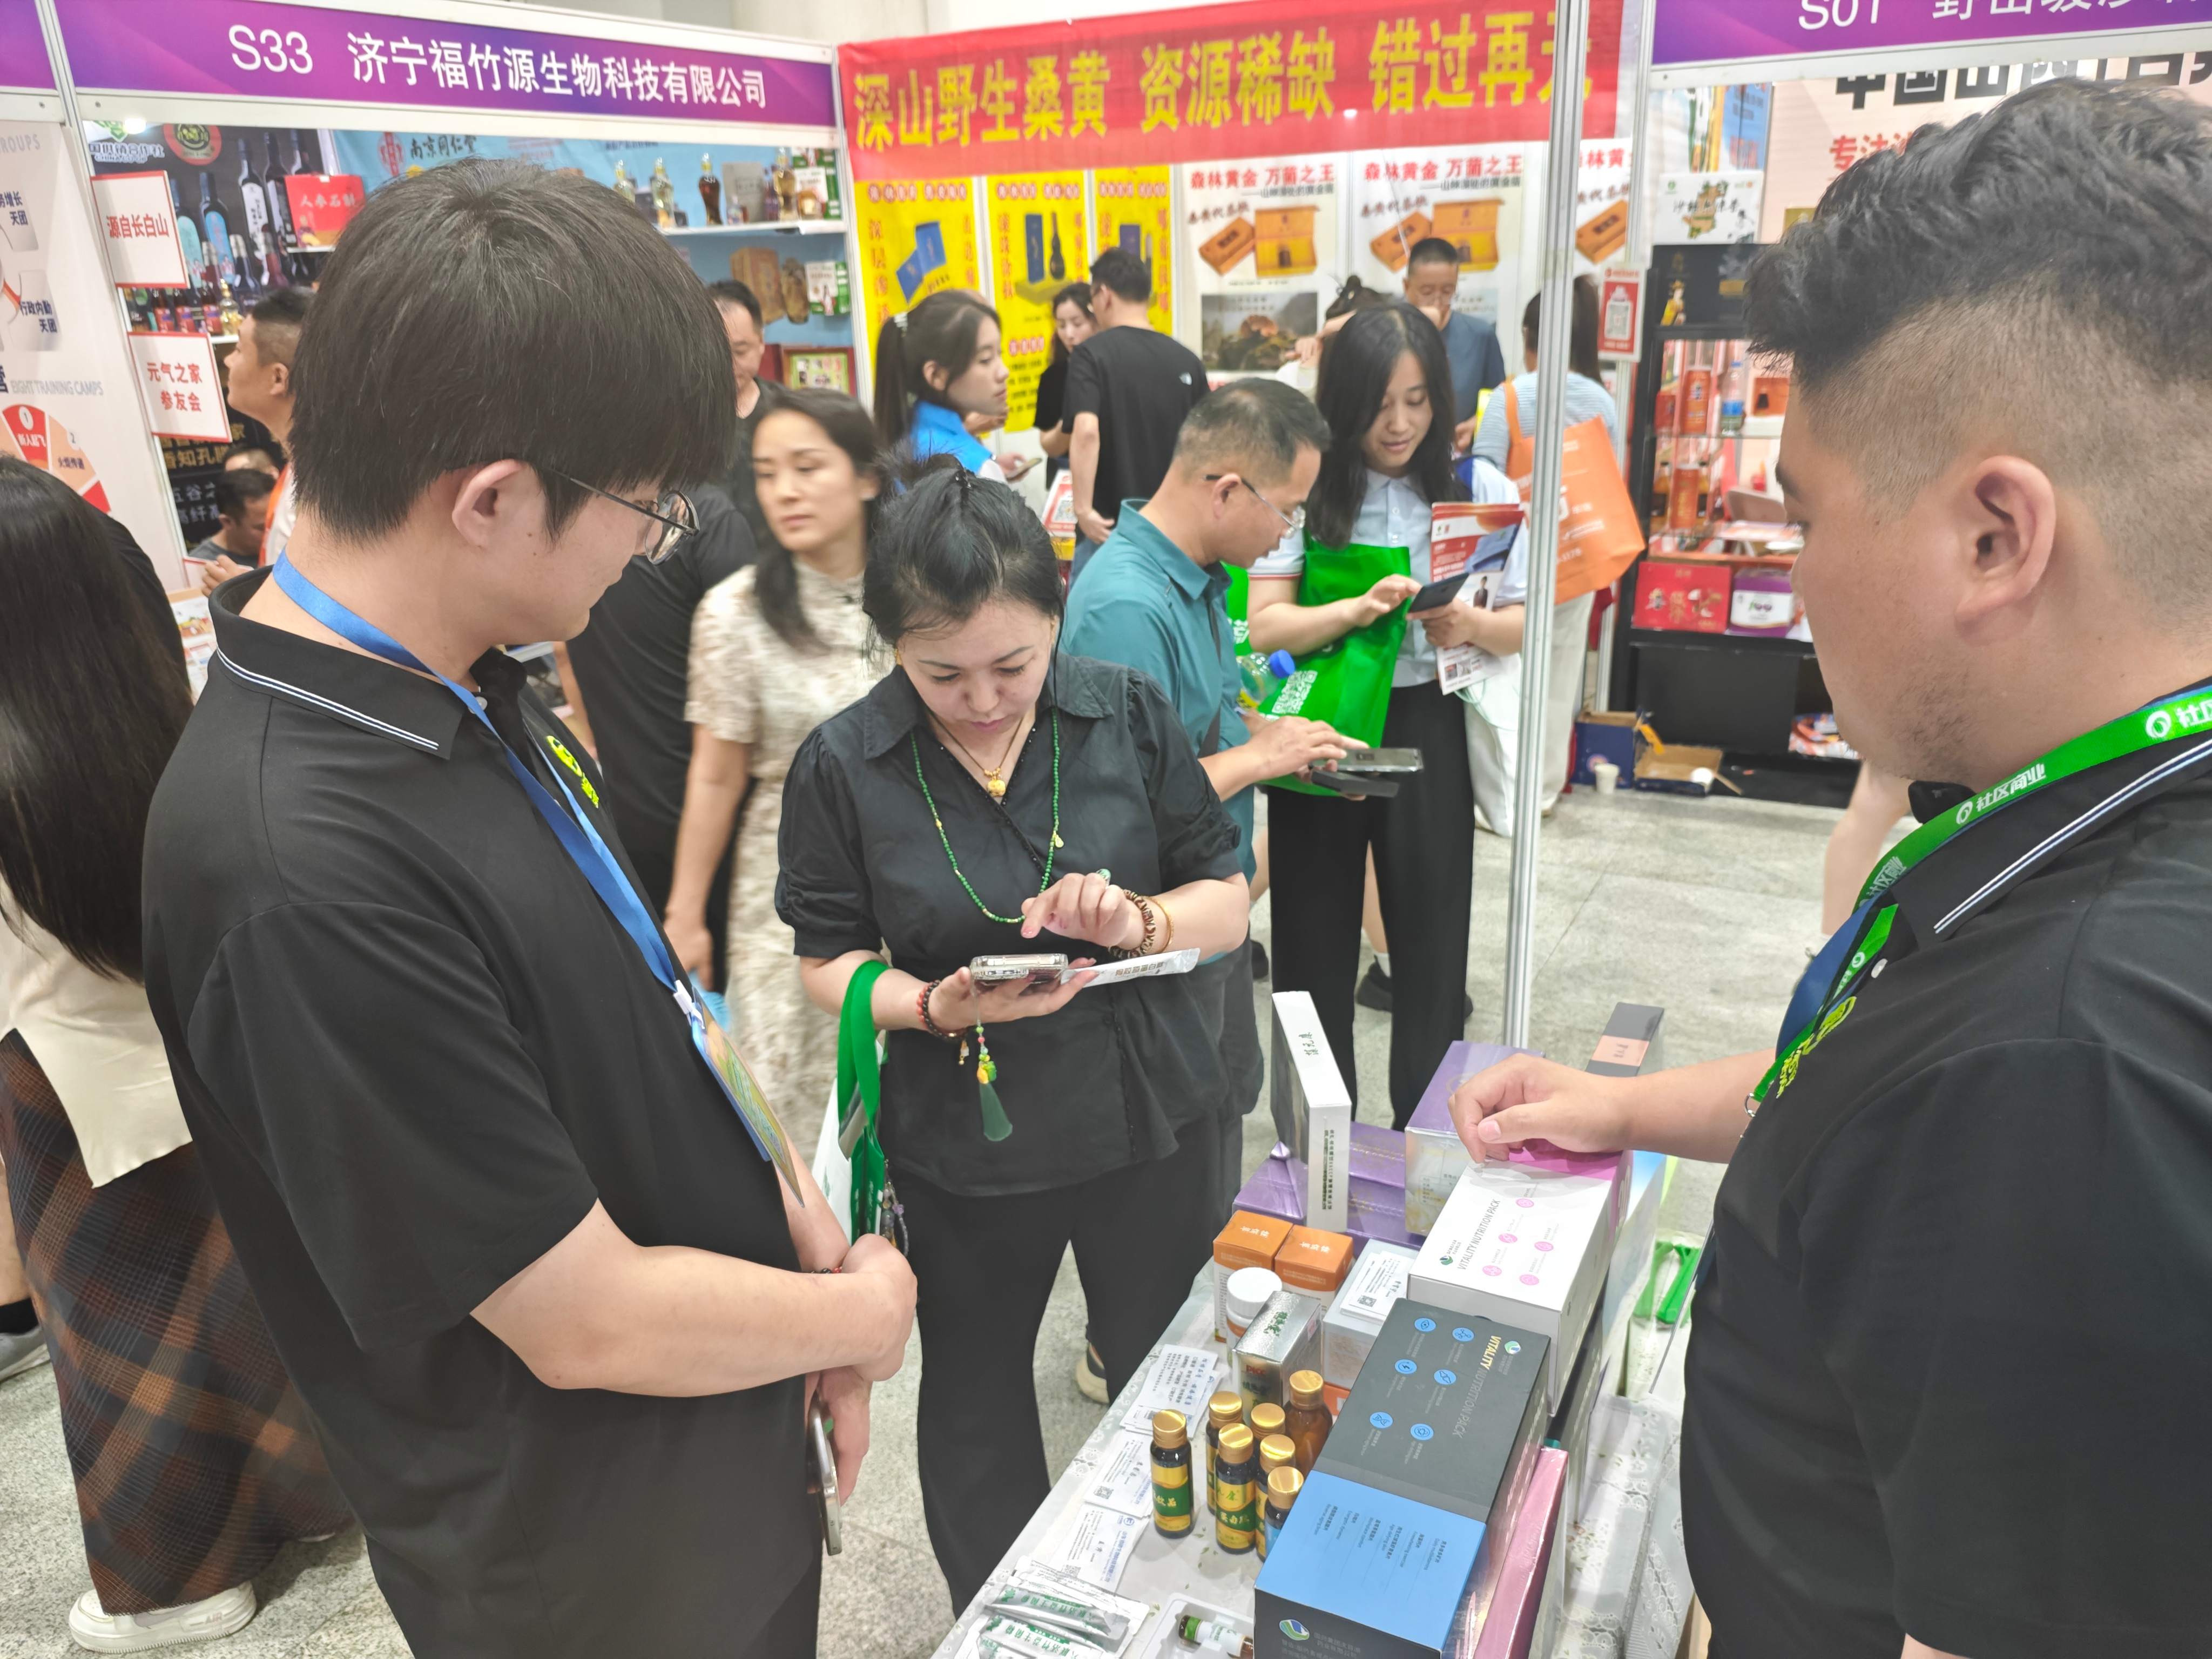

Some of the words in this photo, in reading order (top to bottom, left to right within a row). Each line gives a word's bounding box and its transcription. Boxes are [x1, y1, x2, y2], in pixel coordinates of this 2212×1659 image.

[228, 24, 314, 75] S33
[347, 32, 767, 109] 济宁福竹源生物科技有限公司
[854, 50, 1111, 153] 深山野生桑黄
[1139, 26, 1336, 133] 资源稀缺
[1191, 168, 1258, 189] 森林黄金
[1265, 163, 1335, 186] 万菌之王
[1365, 160, 1438, 180] 森林黄金
[1446, 154, 1522, 178] 万菌之王
[9, 210, 29, 226] 天团
[106, 213, 170, 239] 源自长白山
[20, 300, 52, 316] 行政内勤
[39, 318, 58, 333] 天团
[147, 362, 203, 385] 元气之家
[10, 380, 34, 396] EIGHT
[35, 380, 74, 396] TRAINING
[74, 381, 104, 396] CAMPS
[160, 390, 202, 413] 参友会
[1976, 763, 2046, 813] 社区商业
[1456, 1243, 1478, 1270] VITALITY
[1470, 1213, 1493, 1245] NUTRITION
[1486, 1198, 1501, 1215] PACK
[1480, 1335, 1502, 1371] VITALITY
[1461, 1367, 1488, 1415] NUTRITION
[1452, 1412, 1471, 1439] PACK
